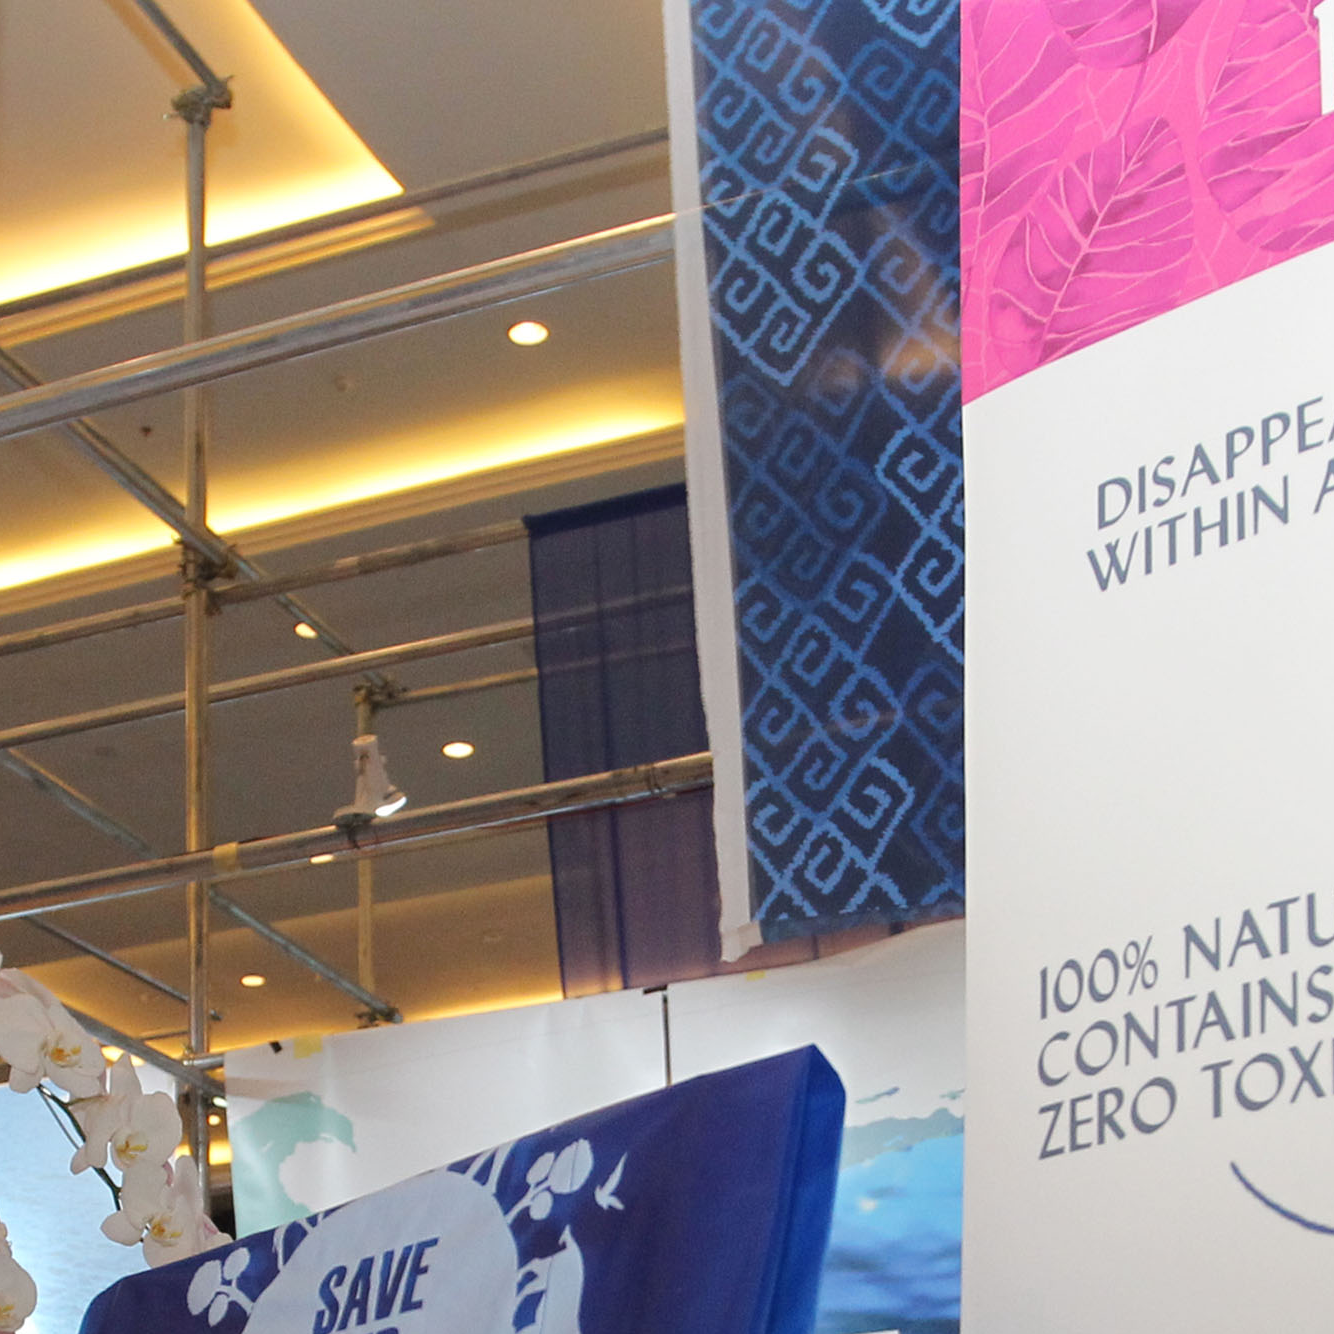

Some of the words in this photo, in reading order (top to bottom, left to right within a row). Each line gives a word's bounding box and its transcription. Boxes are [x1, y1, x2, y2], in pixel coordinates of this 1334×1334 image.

[1085, 475, 1290, 593] WITHIN
[1037, 963, 1334, 1087] CONTAINS
[1038, 935, 1161, 1020] 100%
[1038, 1075, 1178, 1161] ZERO
